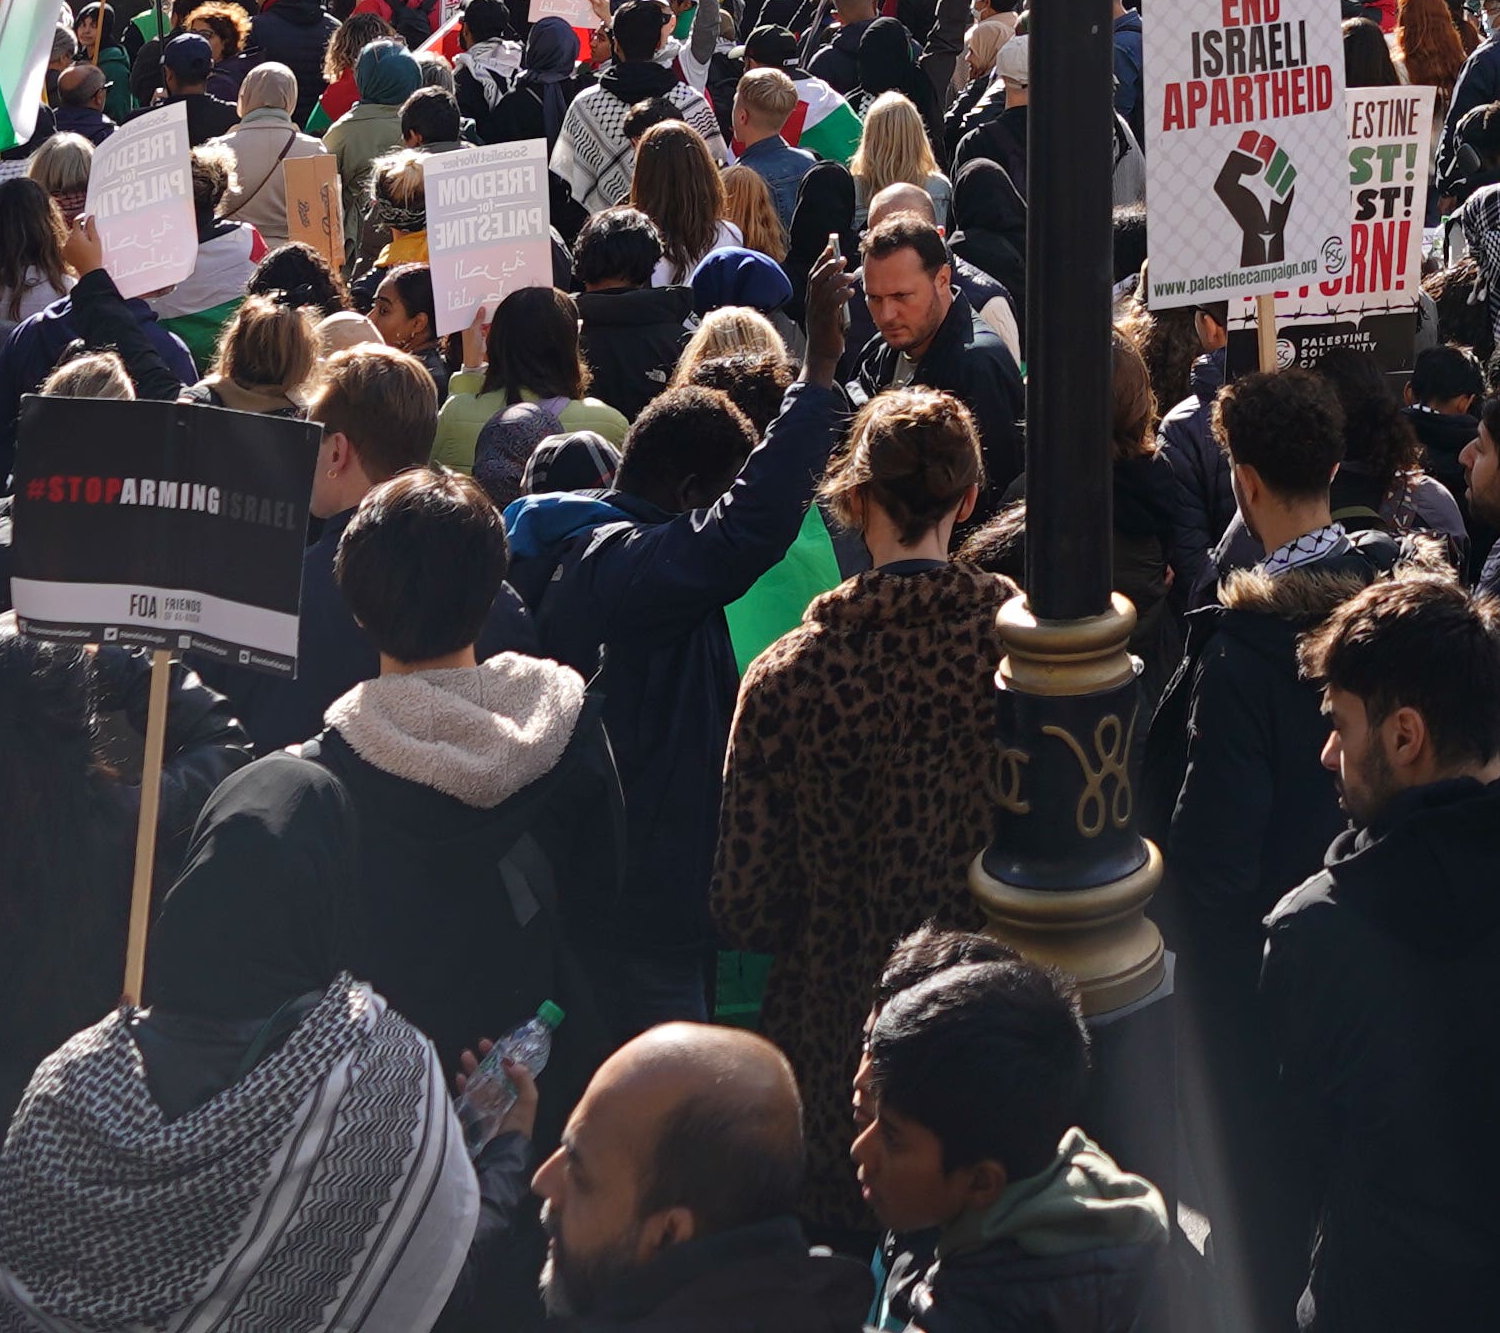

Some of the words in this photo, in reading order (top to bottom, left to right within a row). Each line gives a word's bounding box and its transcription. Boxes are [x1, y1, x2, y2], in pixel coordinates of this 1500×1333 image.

[1191, 19, 1308, 80] ISRAELI
[1162, 64, 1333, 132] APARTHEID
[1153, 257, 1318, 297] www.palestinecampaign.org
[1301, 332, 1371, 347] PALESTINE
[129, 593, 157, 619] FOA
[164, 597, 203, 613] FRIENDS
